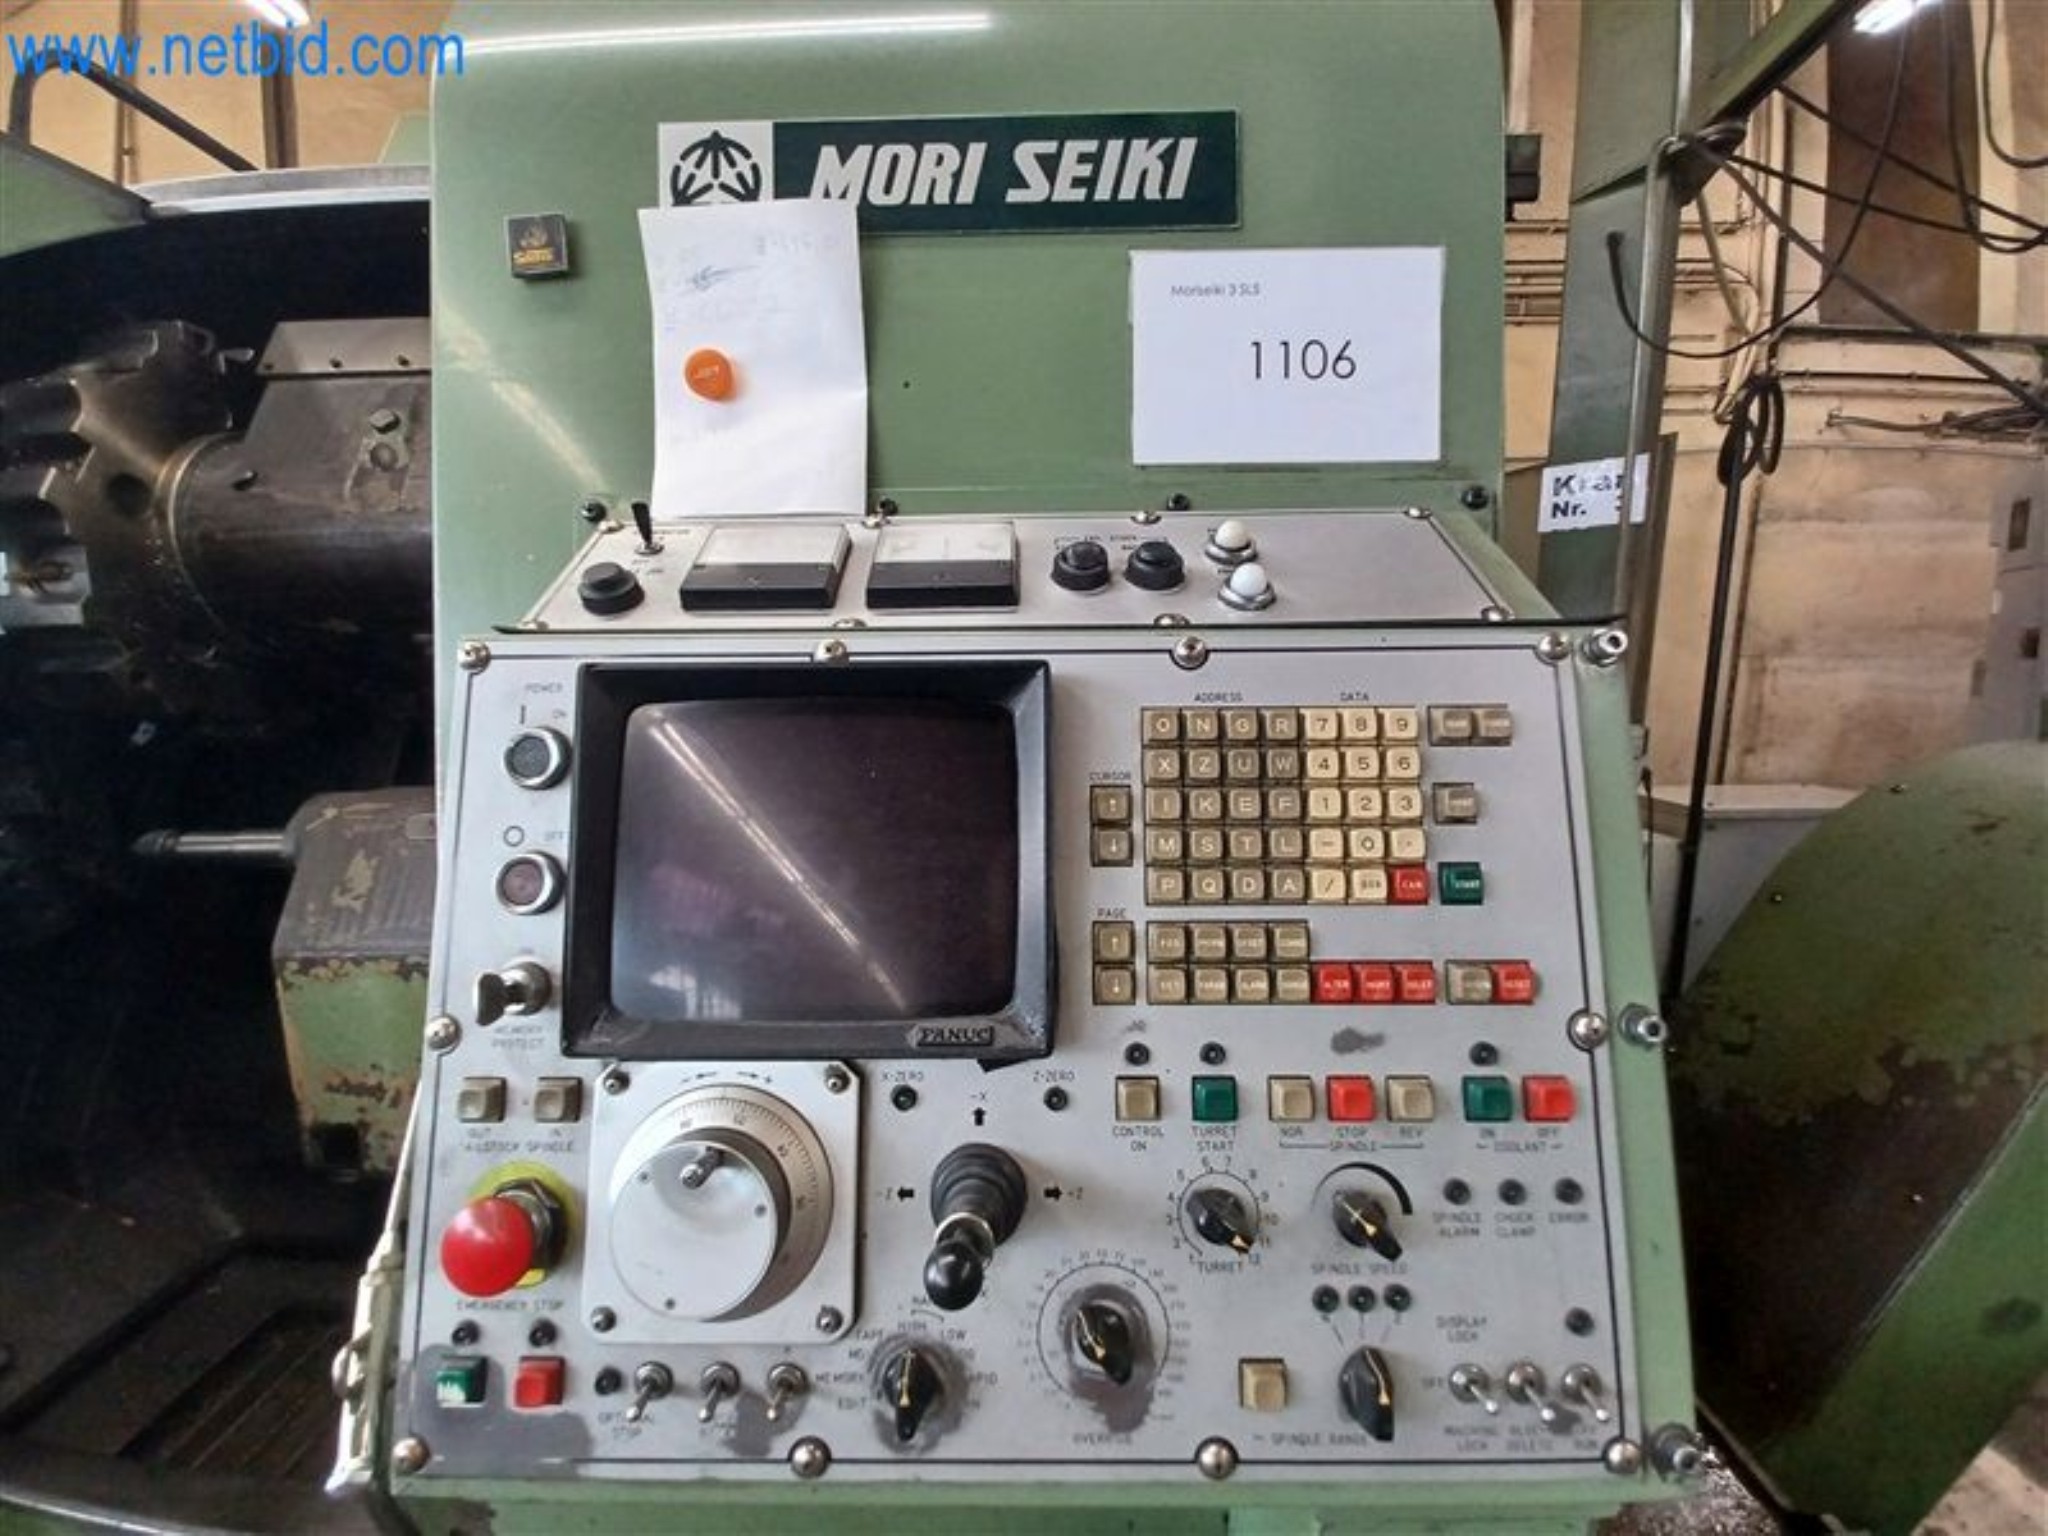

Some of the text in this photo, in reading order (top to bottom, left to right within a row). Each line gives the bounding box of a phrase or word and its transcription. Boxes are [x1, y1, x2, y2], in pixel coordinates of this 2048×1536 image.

[809, 136, 1198, 205] MORI SEIKI
[1250, 339, 1357, 380] 1106
[1552, 501, 1587, 519] Nr.
[1195, 692, 1243, 702] ADDRESS
[1340, 692, 1369, 701] DATA
[1196, 718, 1210, 732] N
[1235, 718, 1249, 732] G
[1275, 718, 1289, 732] R
[1316, 718, 1328, 732] 7
[1356, 718, 1367, 732] 8
[1396, 718, 1408, 732] 9
[1158, 757, 1411, 771] X Z U W 4 5 6
[1200, 797, 1213, 811] K
[1240, 797, 1252, 811] E
[1279, 797, 1292, 811] F
[1322, 797, 1329, 811] 1
[1360, 797, 1372, 811] 2
[1401, 797, 1413, 811] 3
[1158, 837, 1174, 852] M
[1201, 837, 1213, 852] S
[1238, 837, 1255, 852] T
[1280, 837, 1294, 852] L
[1161, 877, 1174, 892] P
[1202, 877, 1216, 892] Q
[1243, 877, 1256, 892] D
[1283, 877, 1297, 892] A
[1097, 908, 1126, 918] PAGE
[922, 1027, 988, 1041] FANUC
[1112, 1126, 1164, 1137] CONTROL
[1130, 1141, 1147, 1151] ON
[1197, 1141, 1233, 1152] START
